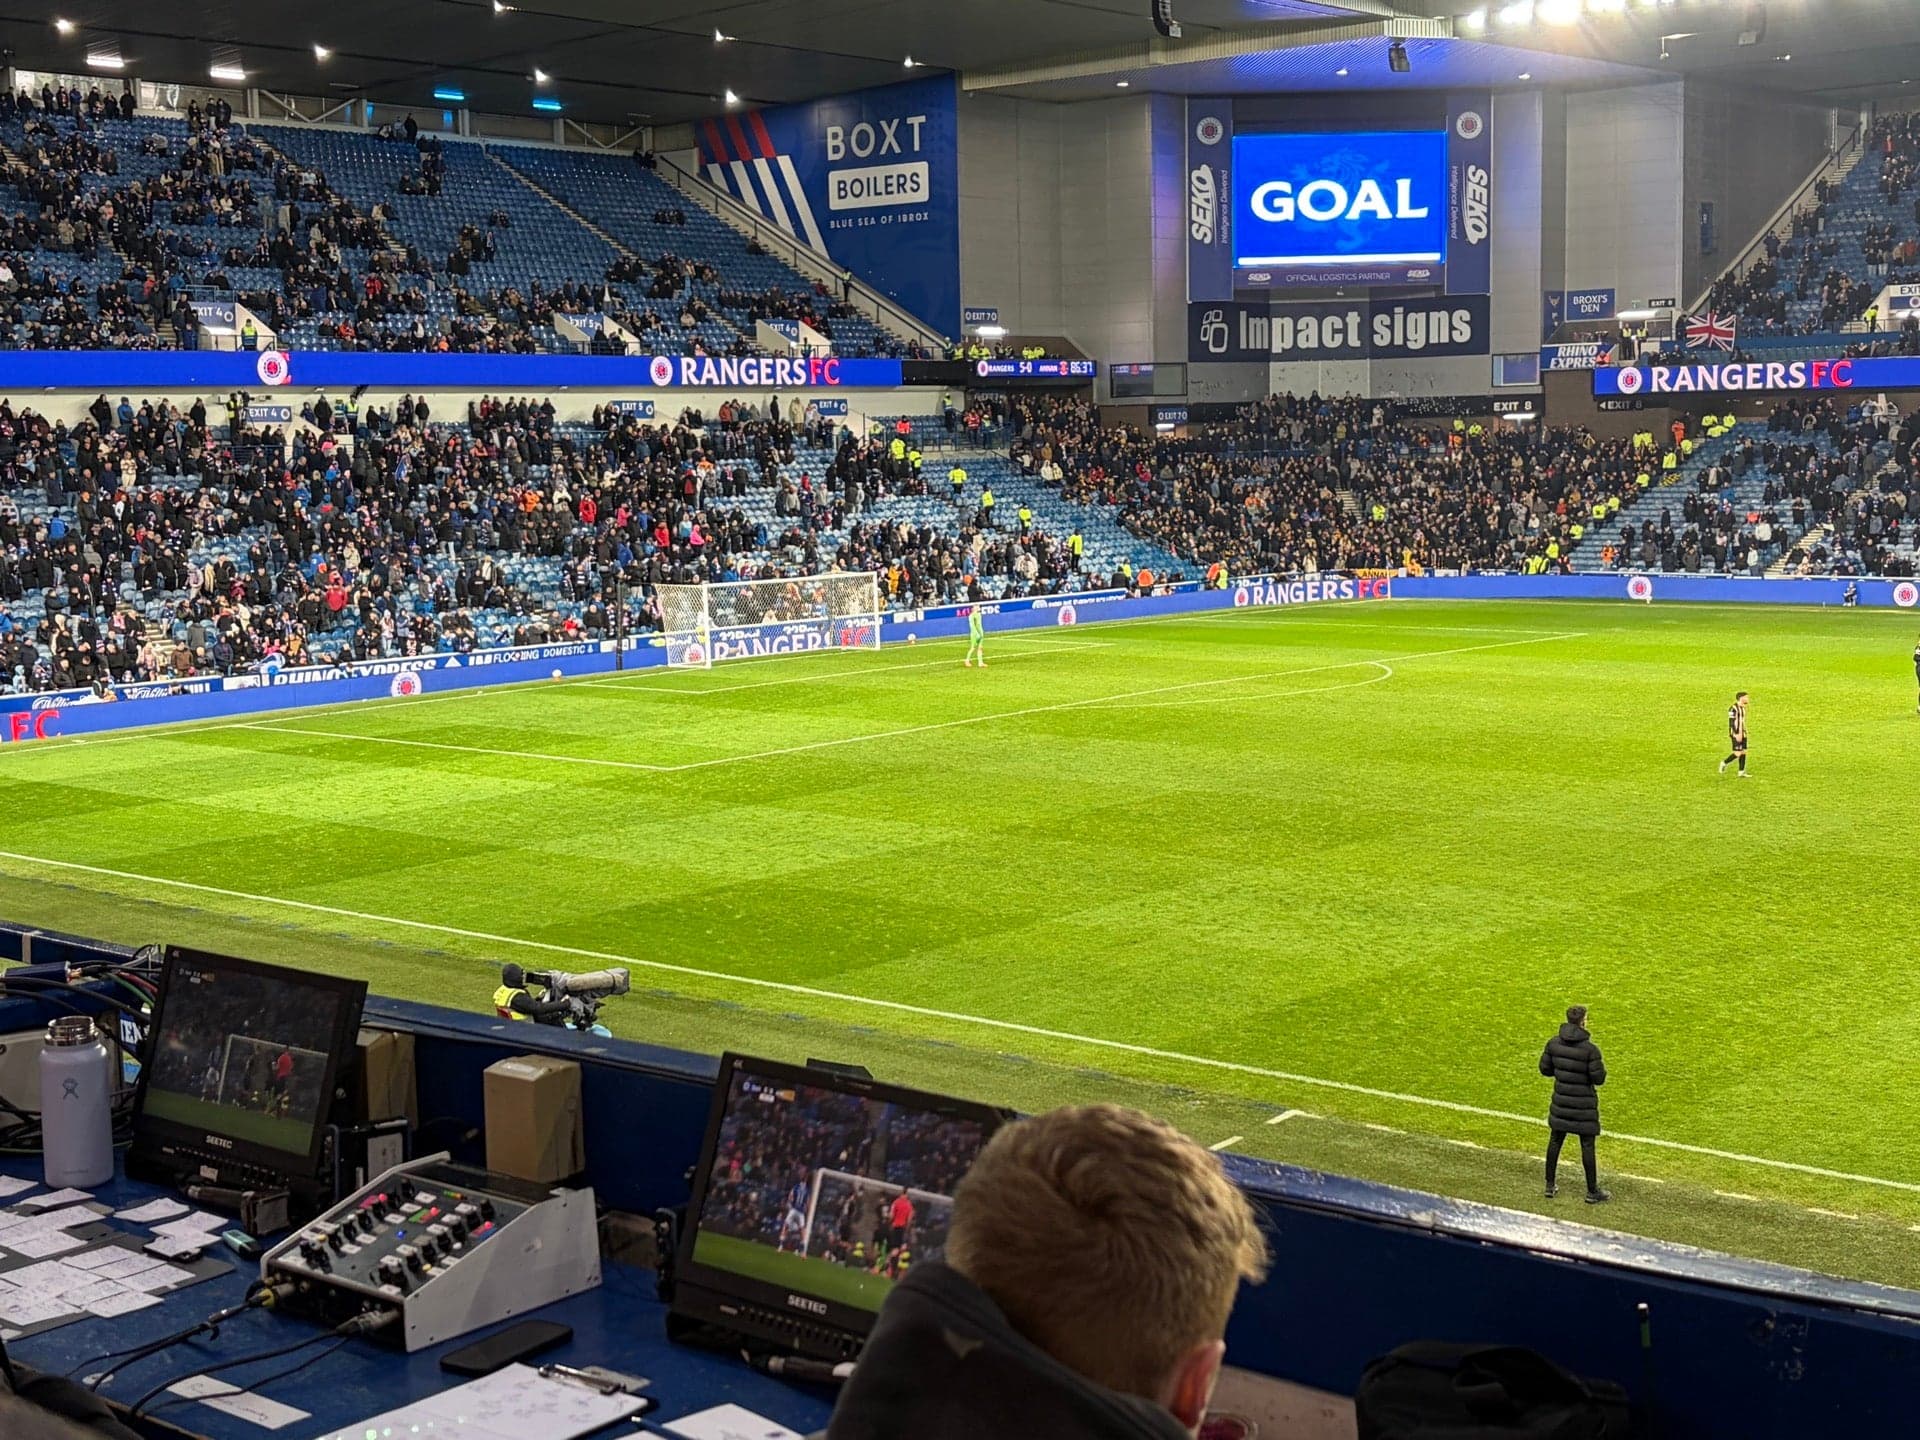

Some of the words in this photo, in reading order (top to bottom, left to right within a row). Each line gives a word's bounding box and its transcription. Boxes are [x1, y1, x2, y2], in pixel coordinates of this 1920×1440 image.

[827, 115, 927, 161] BOXT
[837, 172, 920, 200] BOILERS
[1191, 164, 1213, 245] SEKO
[1250, 178, 1428, 222] GOAL
[1467, 165, 1488, 245] SEKO
[830, 219, 853, 229] BLUE
[858, 217, 876, 226] SEA
[881, 215, 893, 225] OF
[898, 212, 929, 223] IBROX
[1286, 274, 1318, 282] OFFICIAL
[1319, 273, 1357, 281] LOGISTICS
[1359, 272, 1391, 280] PARTNER
[1573, 294, 1608, 305] BROXI'S
[216, 307, 222, 317] 4
[1581, 304, 1600, 313] DEN
[972, 312, 986, 320] EXIT
[1239, 310, 1361, 353] Impact
[1373, 306, 1471, 350] signs
[1557, 345, 1598, 357] RHINO
[988, 364, 1014, 372] RANGERS
[1019, 361, 1032, 373] 5-0
[1549, 357, 1597, 369] EXPRES
[680, 357, 807, 385] RANGERS
[810, 358, 840, 385] FC
[1651, 362, 1806, 392] RANGERS
[1811, 361, 1853, 388] FC
[622, 402, 637, 411] EXIT
[638, 402, 643, 411] 5
[819, 401, 832, 409] EXIT
[1493, 401, 1519, 412] EXIT
[1524, 401, 1532, 410] 8
[1607, 400, 1630, 410] EXIT
[249, 408, 268, 417] EXIT
[271, 408, 277, 417] 4
[1253, 579, 1354, 606] RANGERS
[1358, 578, 1388, 600] FC
[543, 645, 585, 657] DOMESTIC
[9, 709, 60, 742] FC
[788, 1294, 828, 1316] SEETEC
